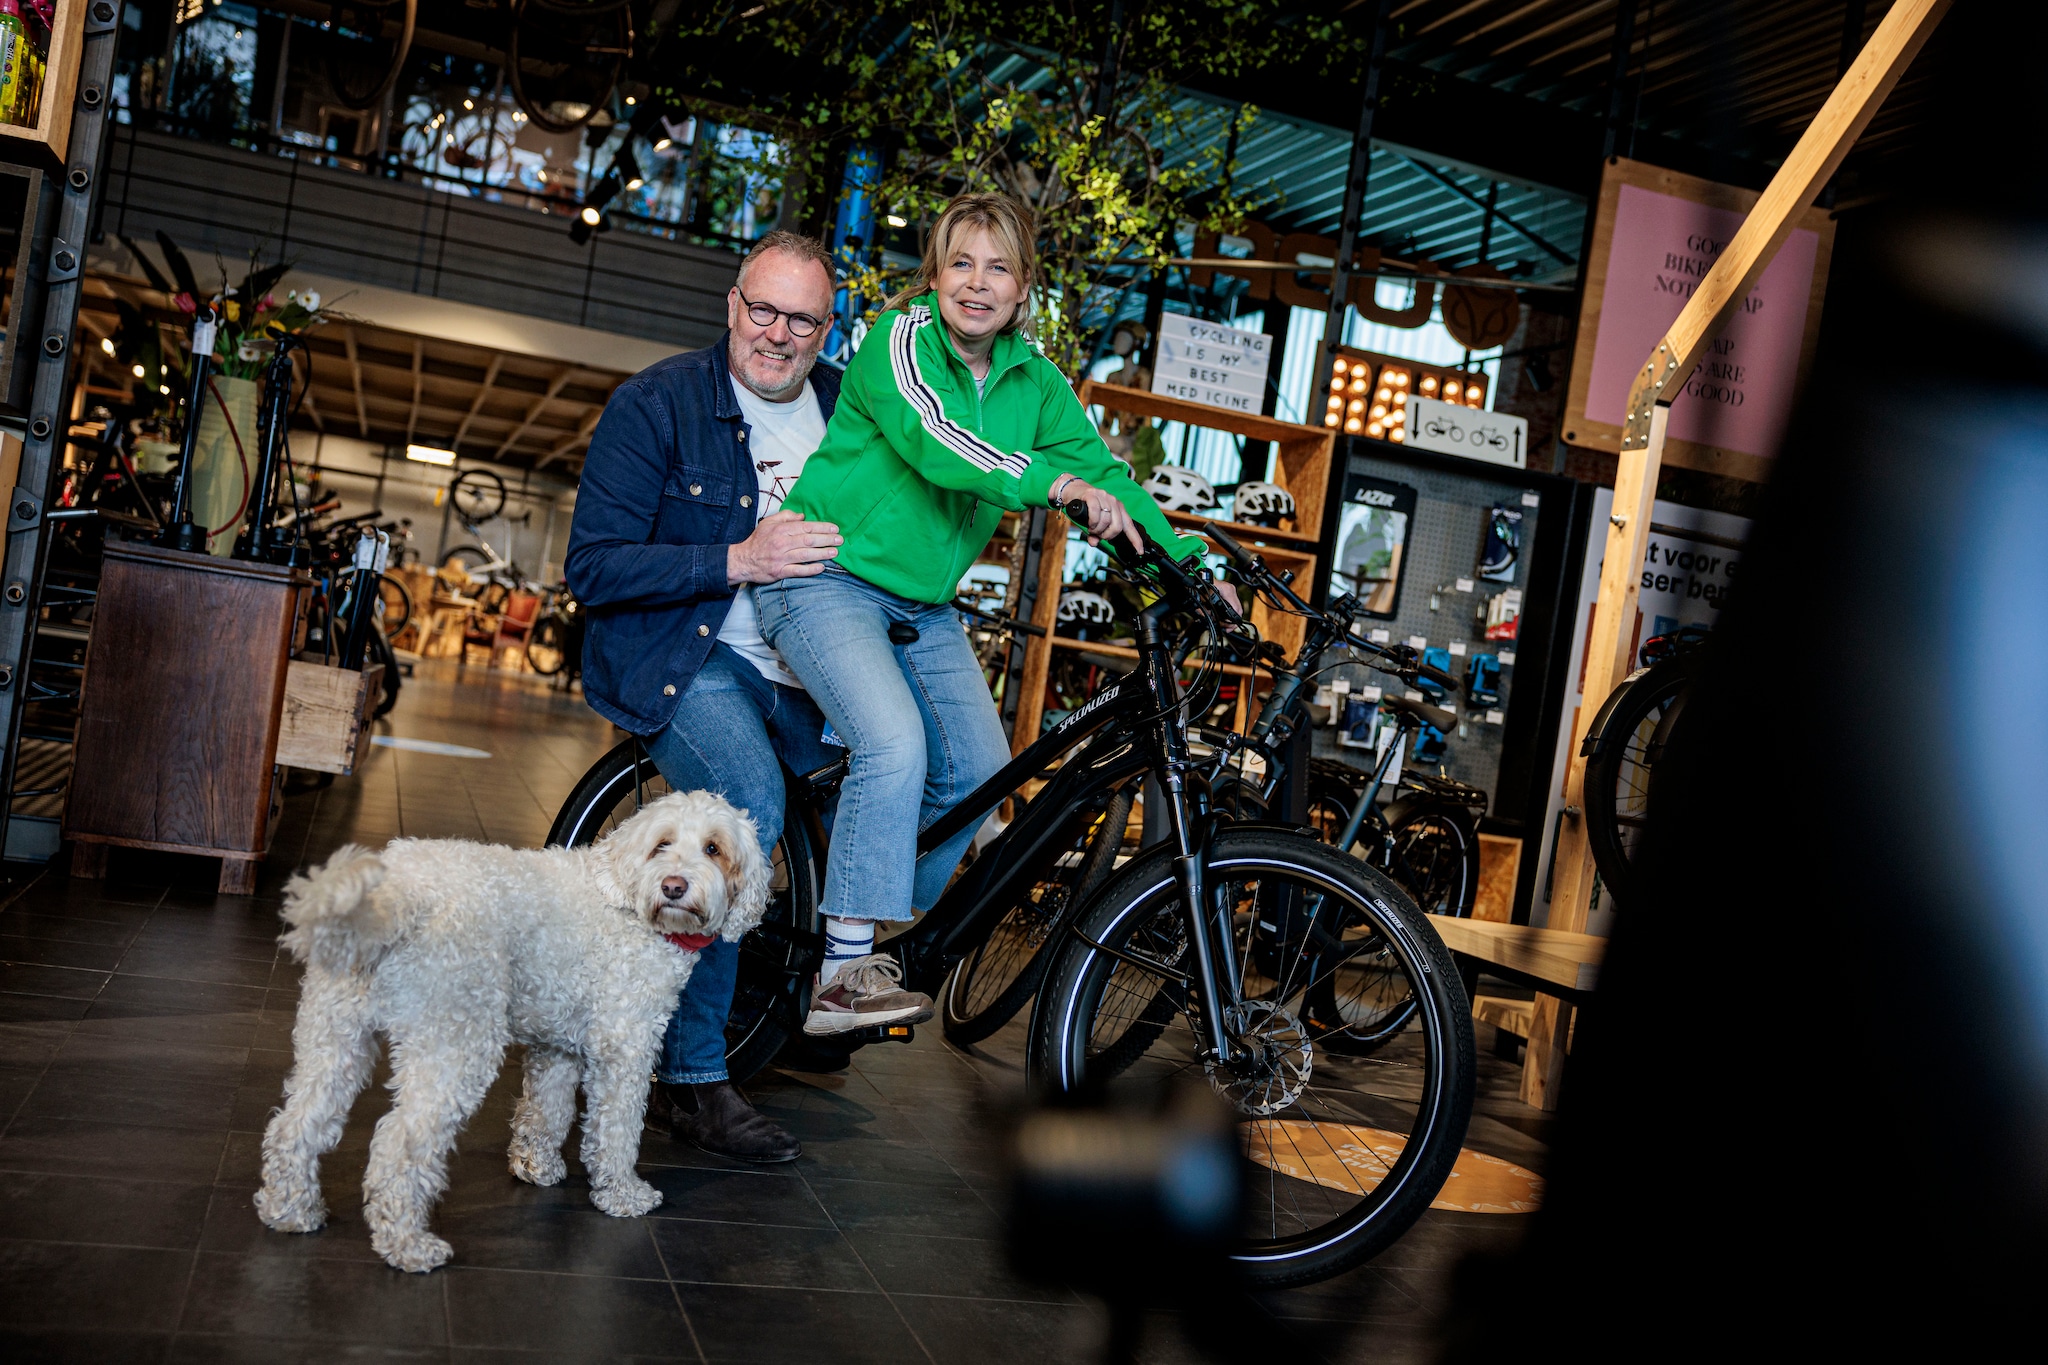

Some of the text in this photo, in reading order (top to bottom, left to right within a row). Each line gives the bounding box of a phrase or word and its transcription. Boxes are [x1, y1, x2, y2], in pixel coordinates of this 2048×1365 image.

[1190, 326, 1264, 351] CYCLING
[1186, 346, 1241, 367] IS MY
[1189, 368, 1229, 384] BEST
[1687, 380, 1744, 407] GOOD
[1664, 547, 1721, 575] voor
[1057, 685, 1120, 735] SPECIALIZED
